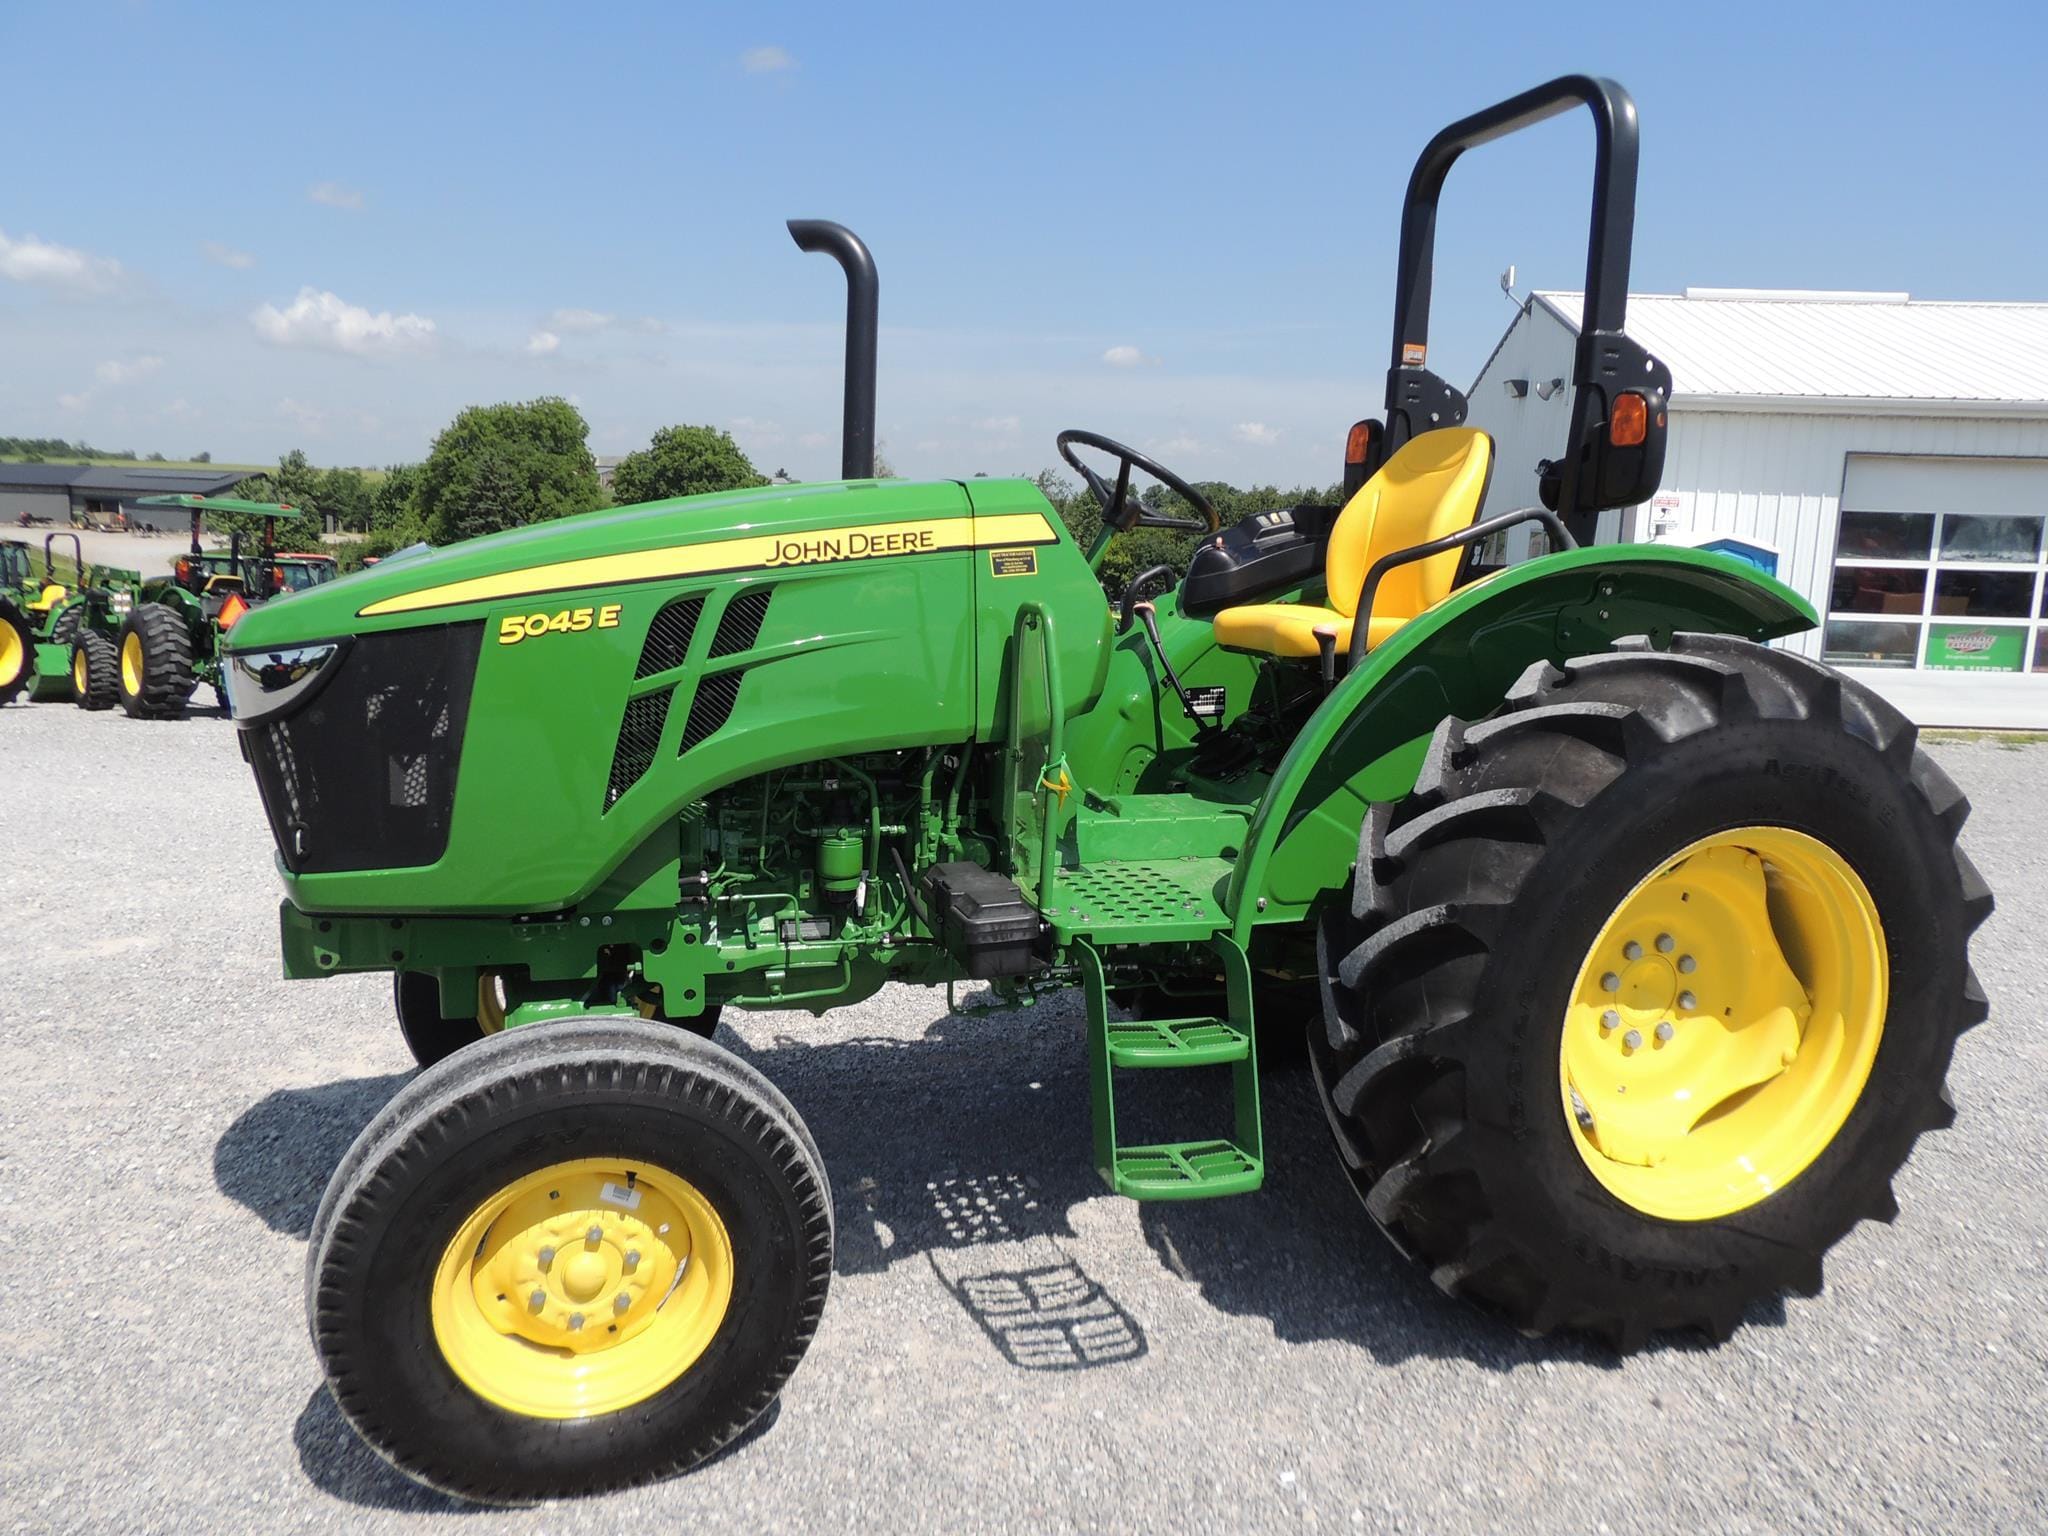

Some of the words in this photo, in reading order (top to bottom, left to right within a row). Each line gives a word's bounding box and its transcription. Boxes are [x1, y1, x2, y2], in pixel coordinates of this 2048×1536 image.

[766, 539, 840, 563] JOHN
[849, 531, 934, 555] DEERE
[499, 607, 594, 645] 5045
[598, 604, 622, 629] E
